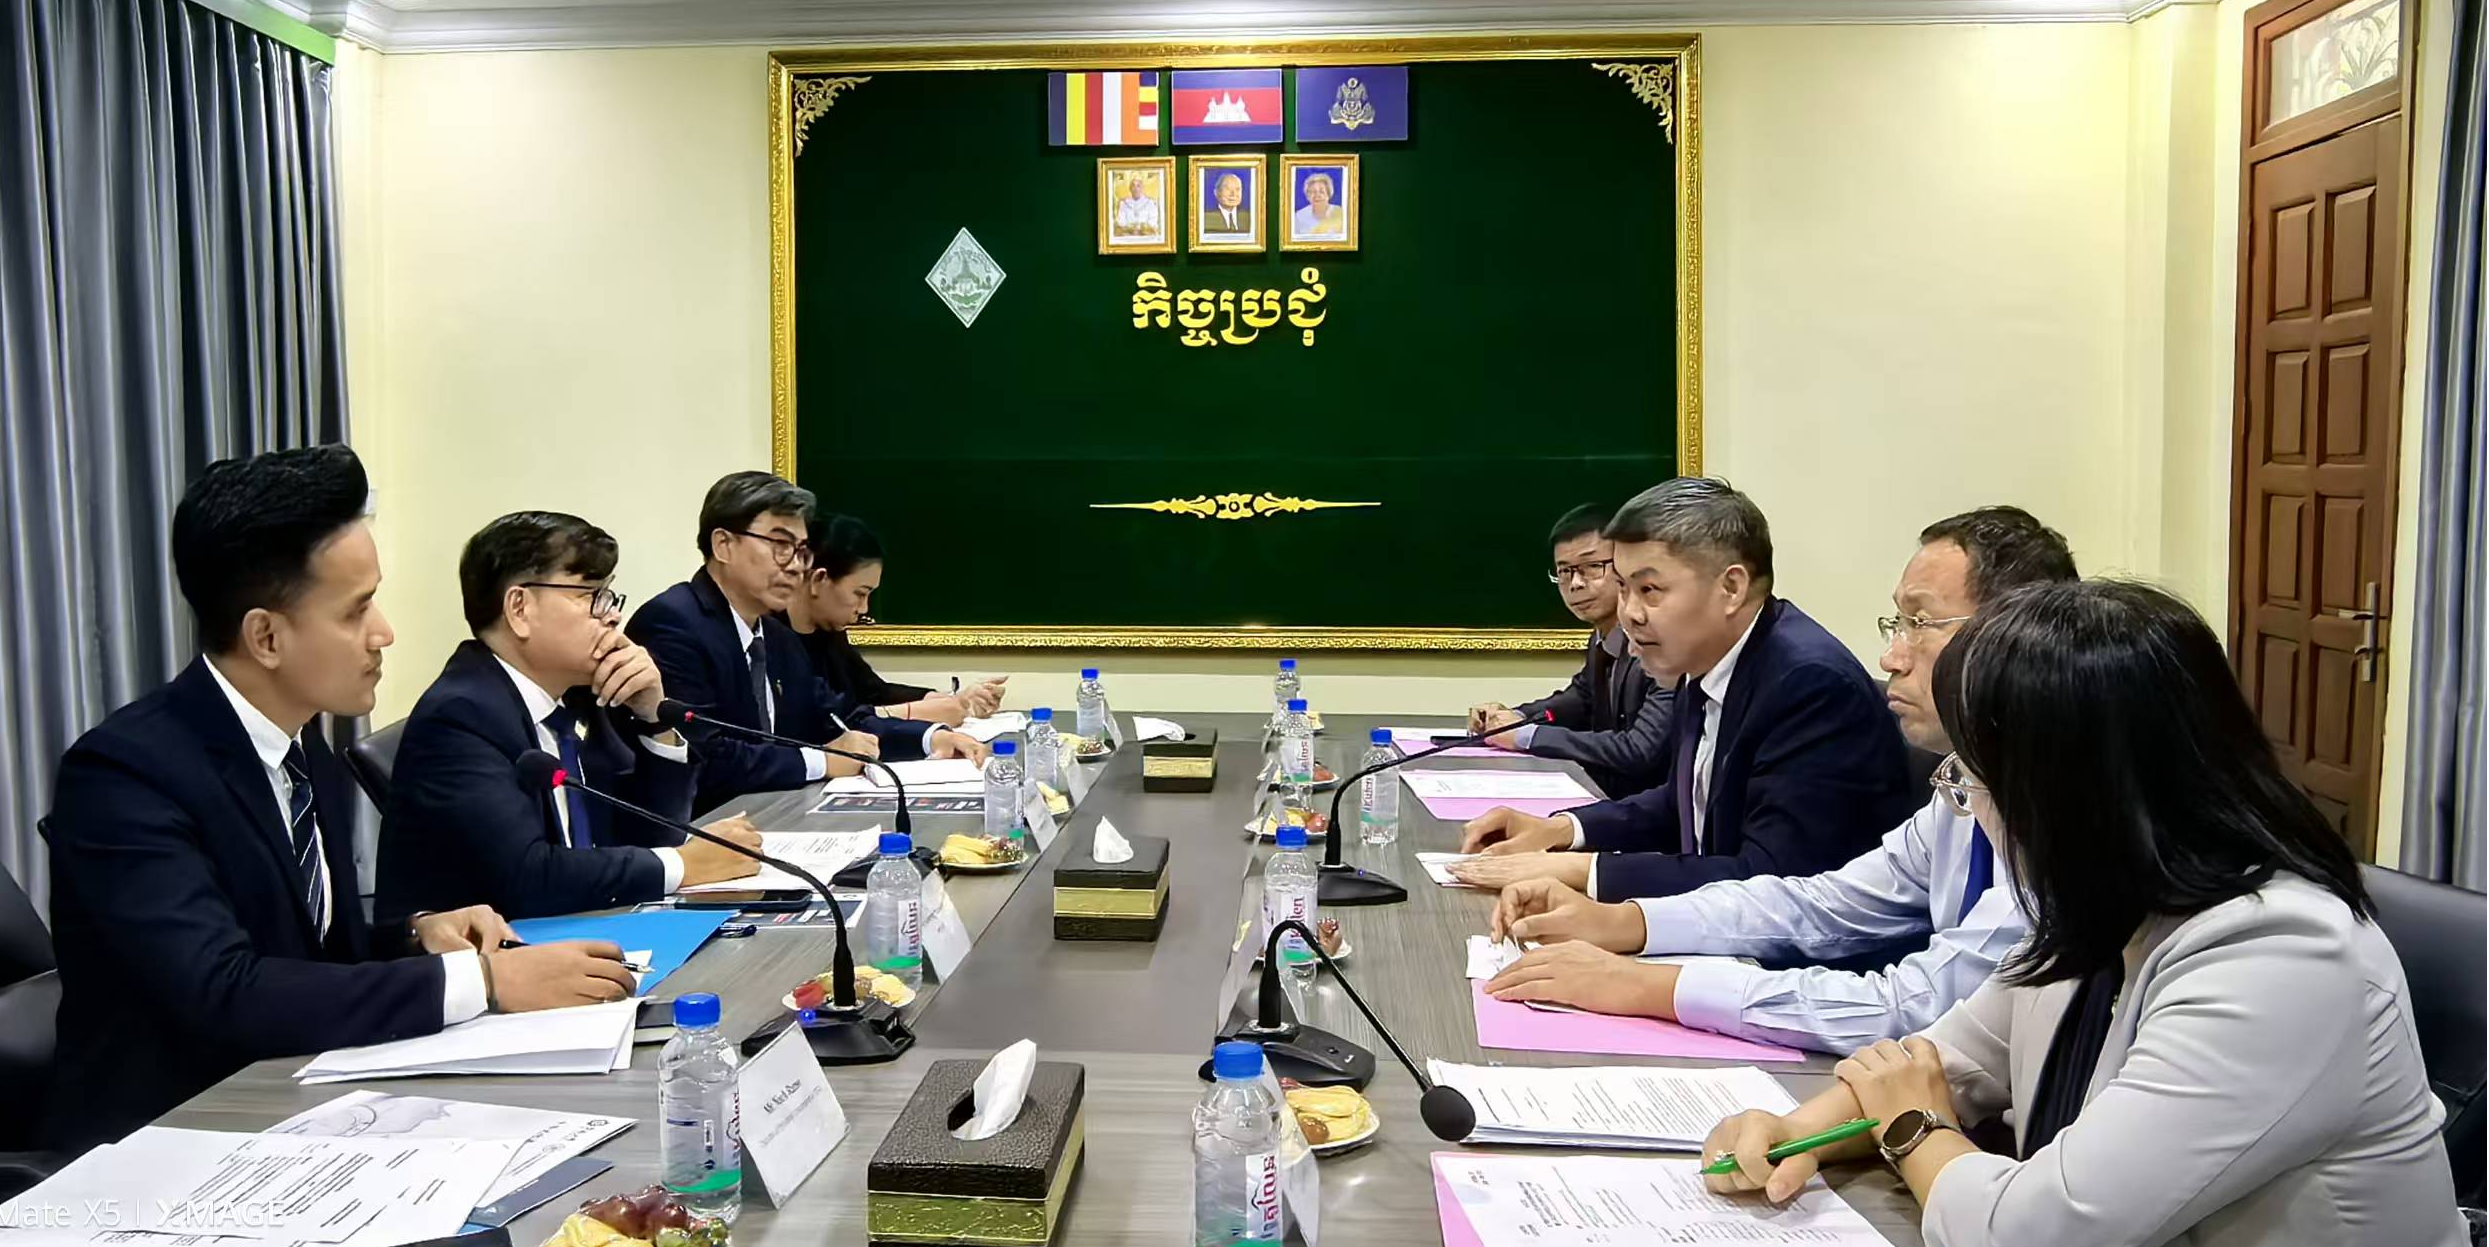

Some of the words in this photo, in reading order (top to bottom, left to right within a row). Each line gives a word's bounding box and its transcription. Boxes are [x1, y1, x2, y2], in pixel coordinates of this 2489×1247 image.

[1133, 267, 1326, 347] កិច្ចប្រជុំ
